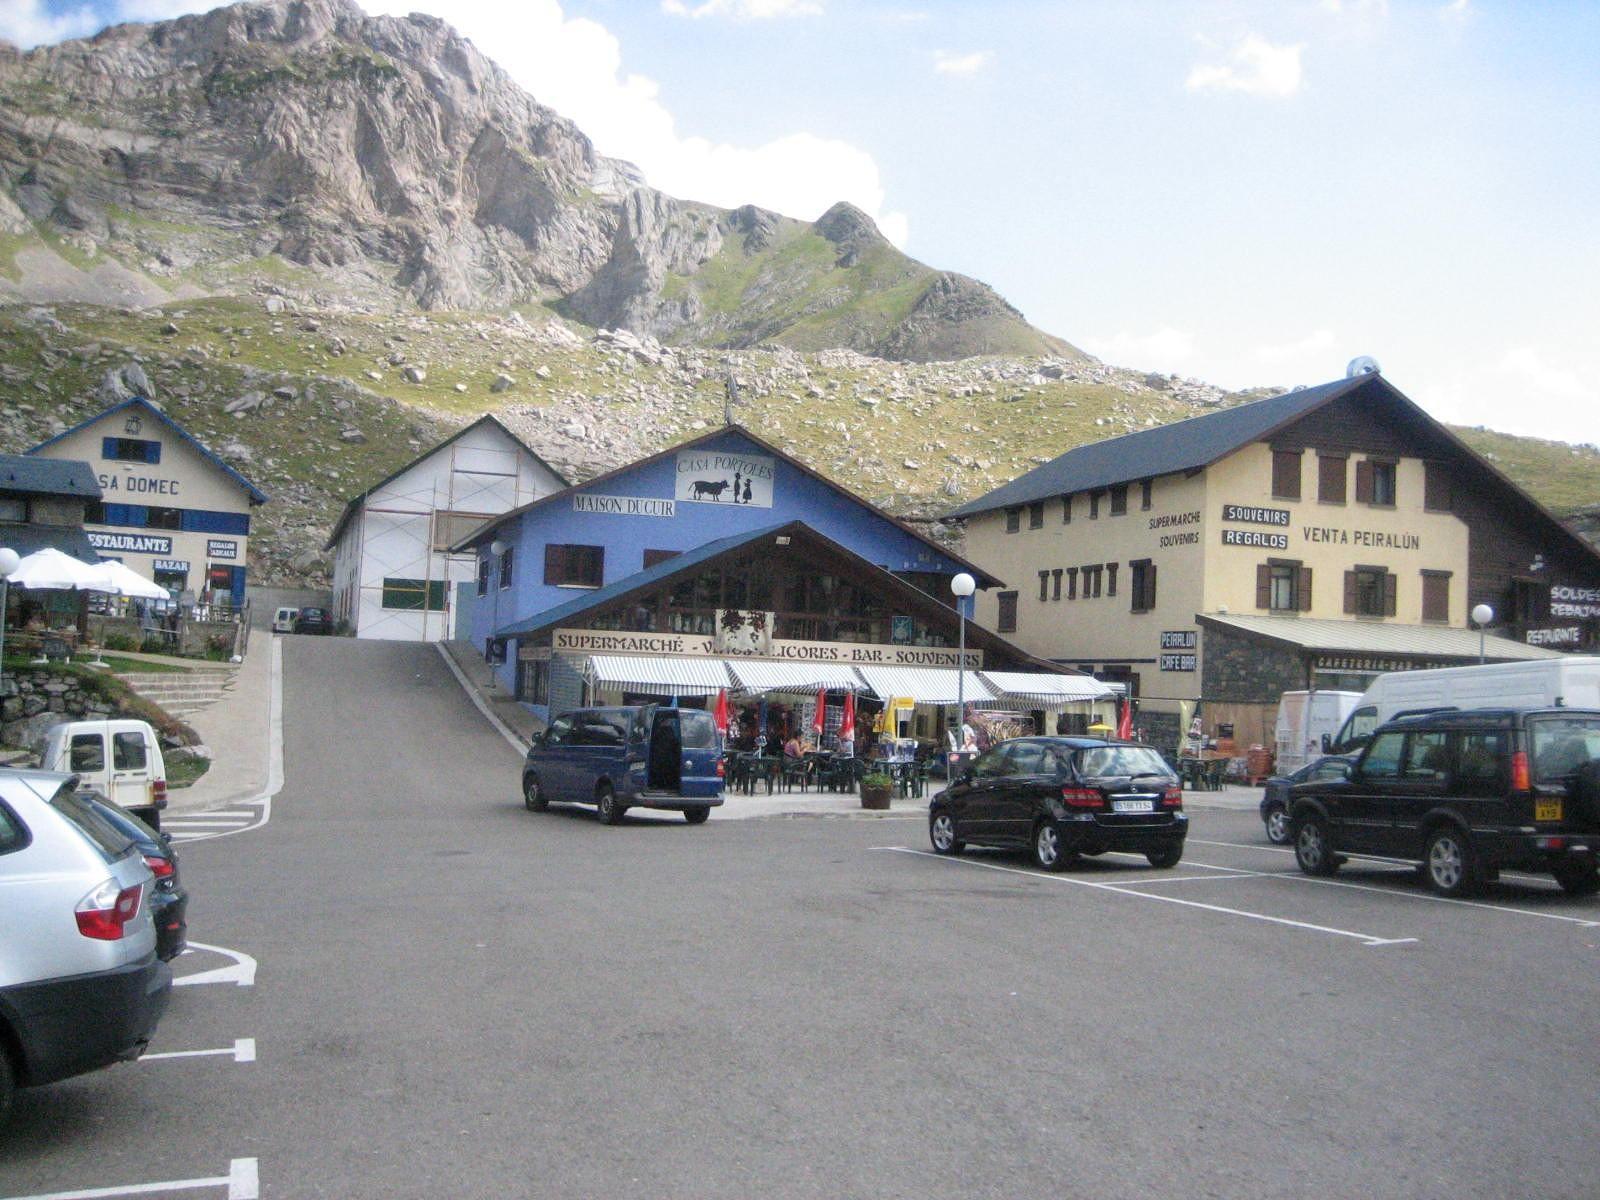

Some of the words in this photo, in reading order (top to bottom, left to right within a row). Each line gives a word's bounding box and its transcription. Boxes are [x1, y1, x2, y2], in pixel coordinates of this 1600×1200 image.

[677, 456, 709, 474] CASA
[713, 456, 774, 480] PORTOLES
[127, 477, 180, 495] DOMEC
[576, 495, 623, 513] MAISON
[628, 498, 643, 513] DU
[644, 500, 673, 516] CUIR
[1149, 511, 1201, 530] SUPERMARCHE
[1228, 506, 1288, 525] SOUVENIRS
[1160, 531, 1200, 548] SOUVENIRS
[1226, 531, 1287, 548] REGALOS
[1303, 526, 1348, 545] VENTA
[1353, 530, 1420, 550] PEIRALÚN
[155, 560, 188, 571] BAZAR
[558, 634, 684, 653] SUPERMARCHÉ
[852, 649, 883, 662] BAR
[896, 650, 980, 667] SOUVENIRS
[1181, 656, 1197, 670] BAR
